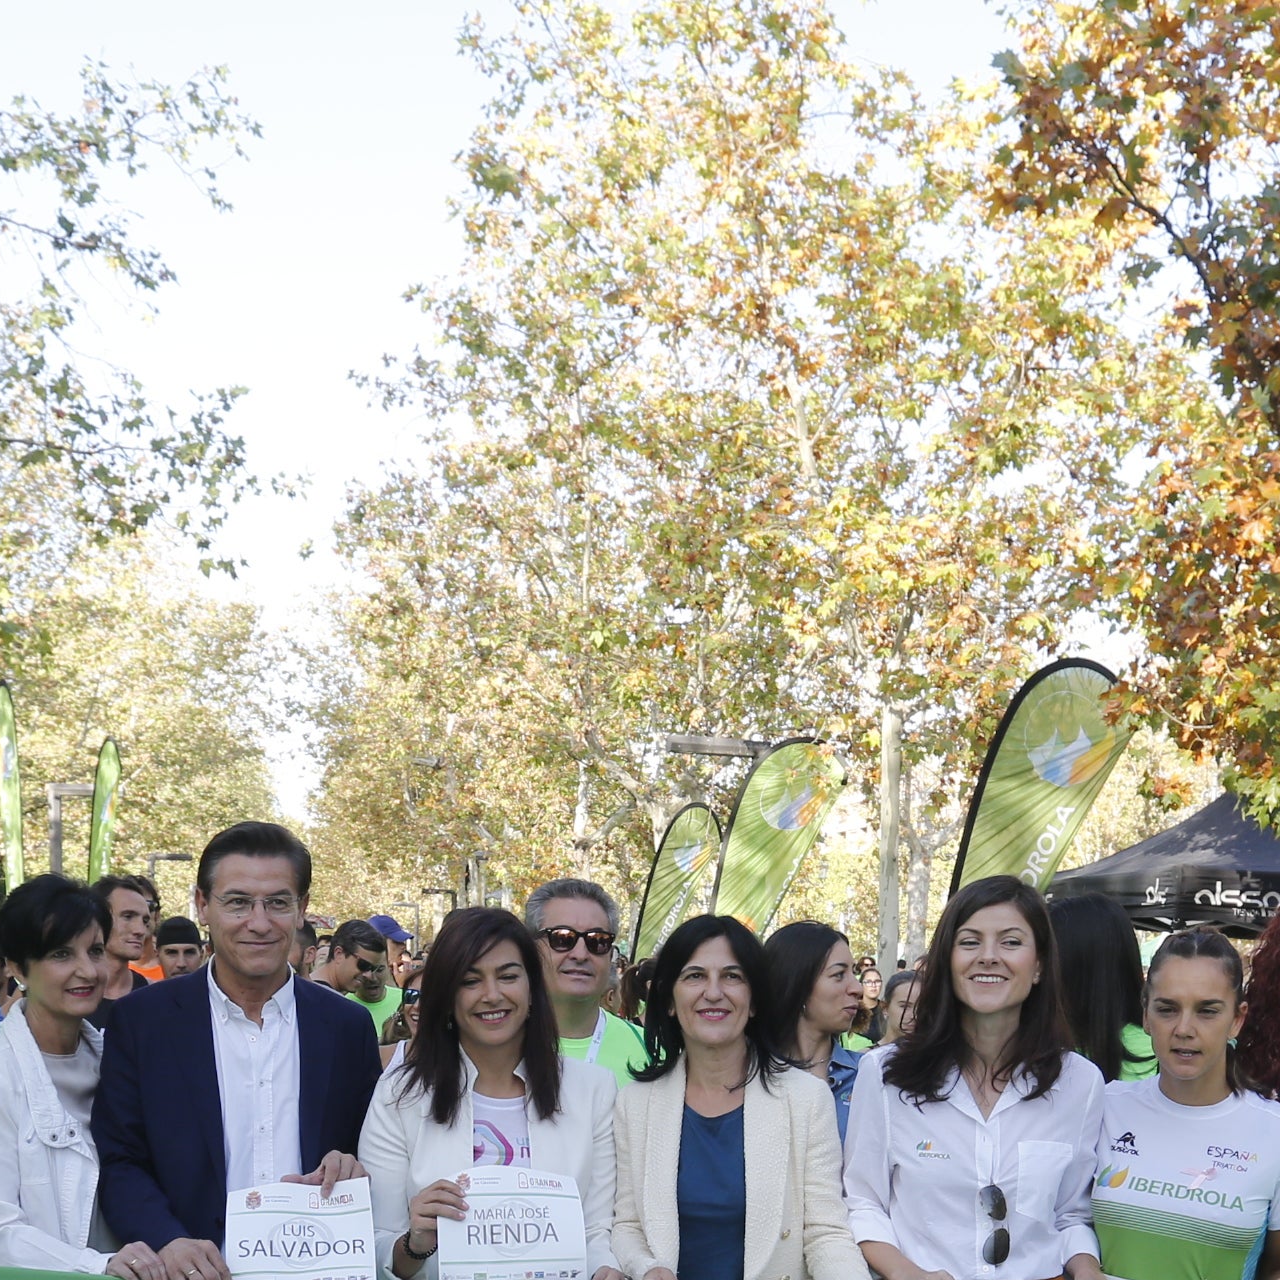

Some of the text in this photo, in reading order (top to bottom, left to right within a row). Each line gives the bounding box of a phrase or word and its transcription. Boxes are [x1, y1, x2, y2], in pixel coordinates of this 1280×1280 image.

[1207, 1146, 1258, 1163] ESPAÑA
[1128, 1176, 1244, 1212] IBERDROLA
[473, 1206, 550, 1220] MARÍA JOSÉ
[282, 1224, 315, 1237] LUIS
[467, 1222, 559, 1245] RIENDA
[238, 1239, 365, 1258] SALVADOR
